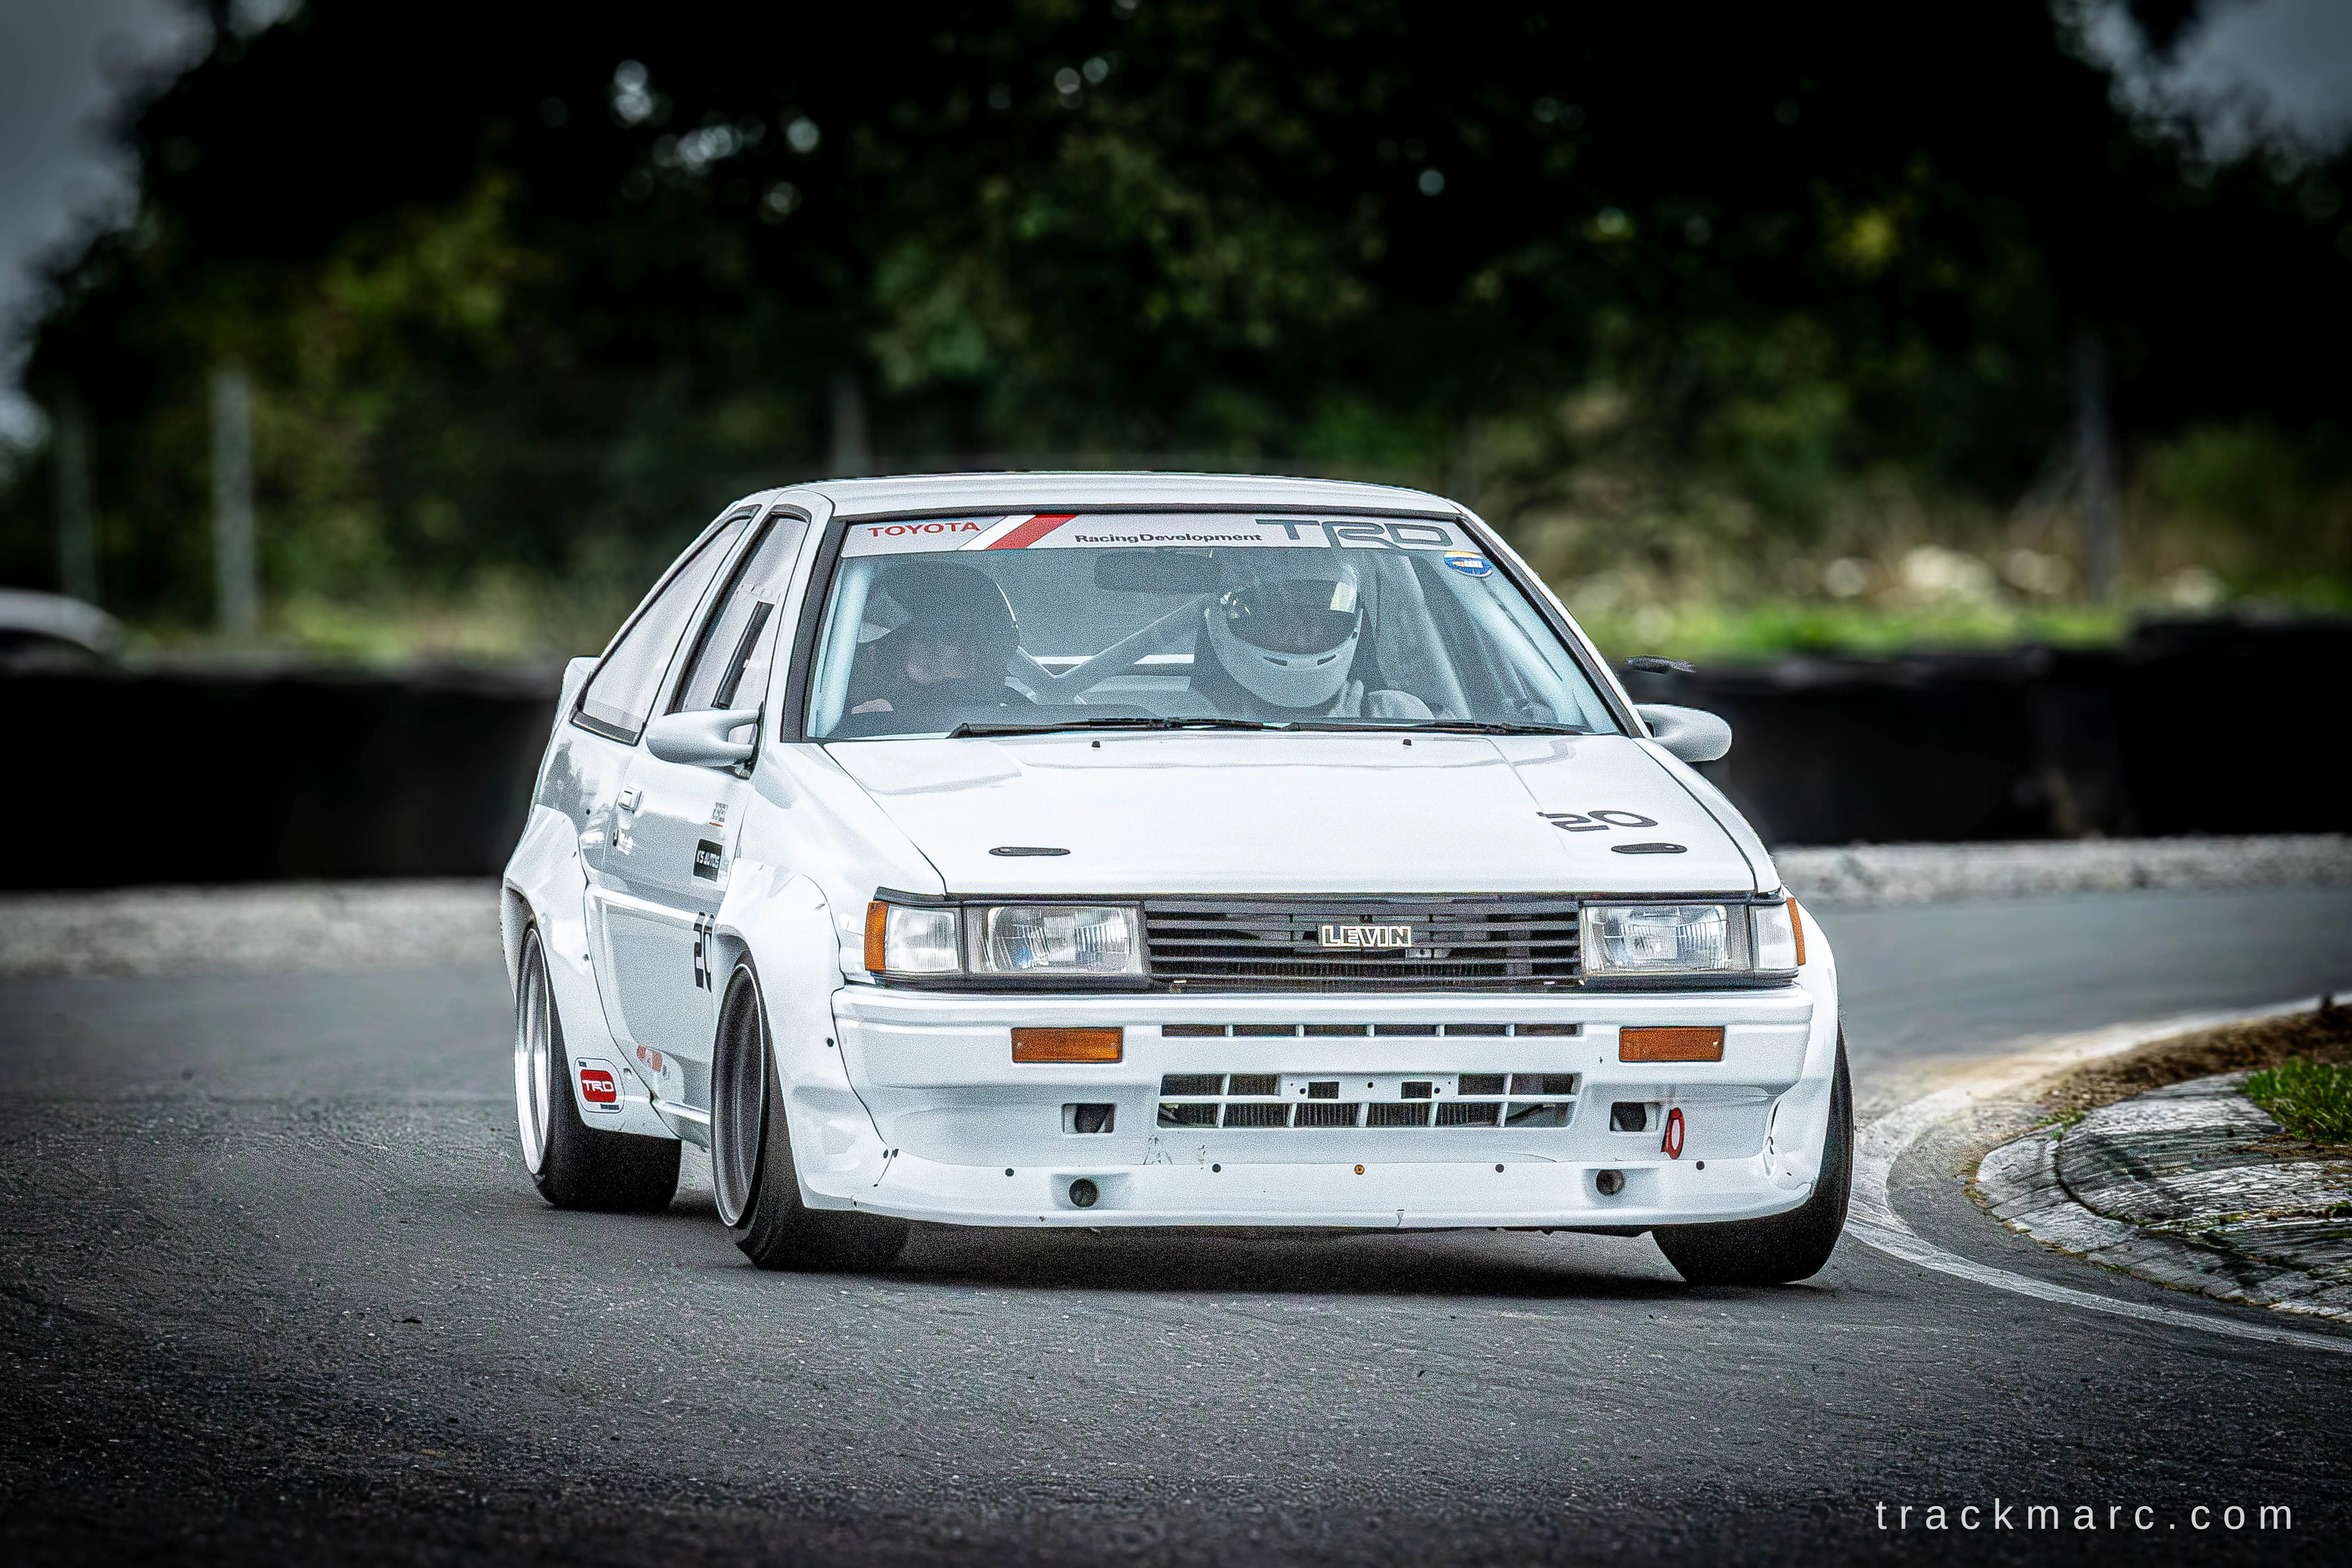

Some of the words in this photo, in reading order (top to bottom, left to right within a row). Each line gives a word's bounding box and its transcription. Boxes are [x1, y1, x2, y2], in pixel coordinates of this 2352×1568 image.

[867, 522, 981, 537] TOYOTA
[1255, 519, 1453, 551] TRD
[1536, 810, 1658, 832] 20
[1322, 926, 1412, 947] LEVIN
[582, 1080, 614, 1092] TRD
